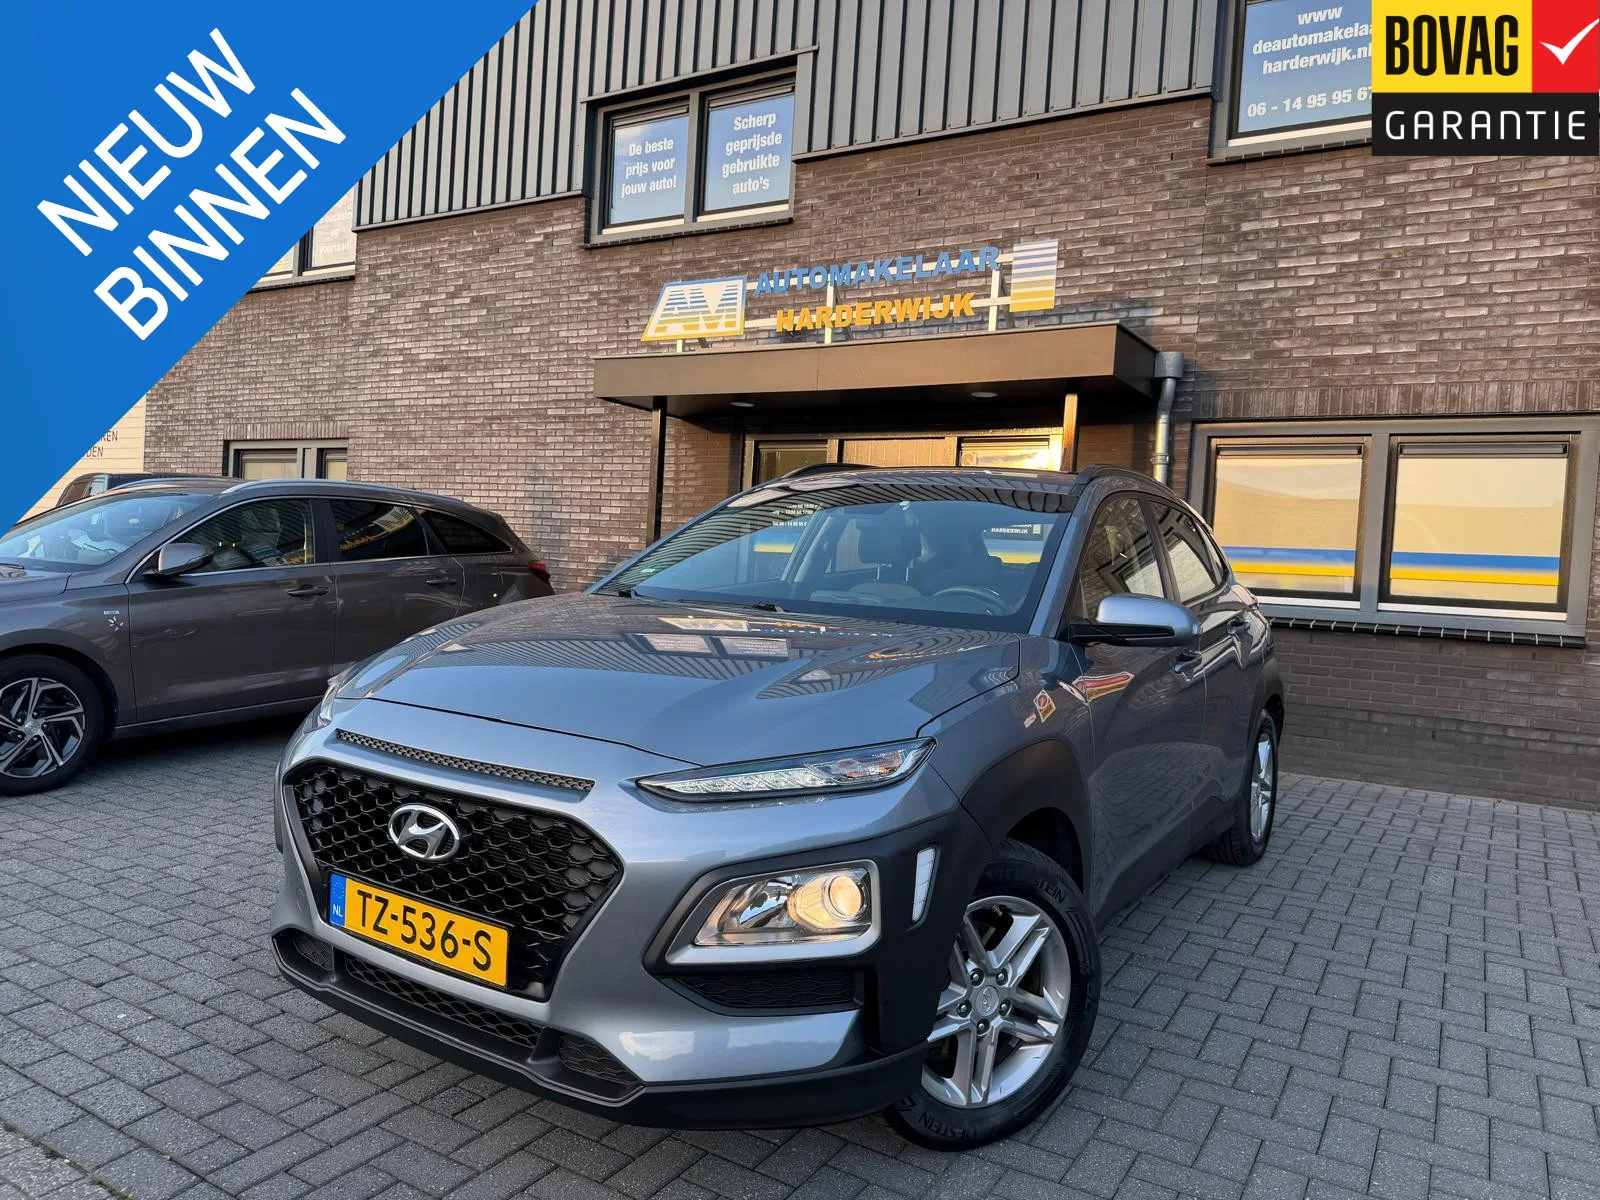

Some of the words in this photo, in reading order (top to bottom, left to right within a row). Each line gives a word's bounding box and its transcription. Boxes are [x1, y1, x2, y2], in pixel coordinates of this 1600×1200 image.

[1297, 6, 1343, 26] www
[1252, 22, 1372, 55] deautomakela
[1247, 102, 1267, 118] 06
[1283, 97, 1303, 112] 14
[1306, 92, 1327, 108] 95
[1331, 89, 1352, 105] 95
[733, 112, 776, 132] Scherp
[628, 143, 643, 157] De
[645, 137, 674, 154] beste
[725, 131, 783, 156] geprijsde
[625, 161, 649, 179] prijs
[651, 157, 676, 173] voor
[721, 153, 780, 178] gebruikte
[620, 182, 648, 199] jouw
[649, 174, 677, 193] auto!
[732, 176, 770, 195] auto's
[753, 246, 1000, 297] AUTOMAKELAAR
[775, 291, 977, 333] HARDERWIJK
[332, 905, 344, 918] NL
[357, 889, 492, 972] TZ-536-S
